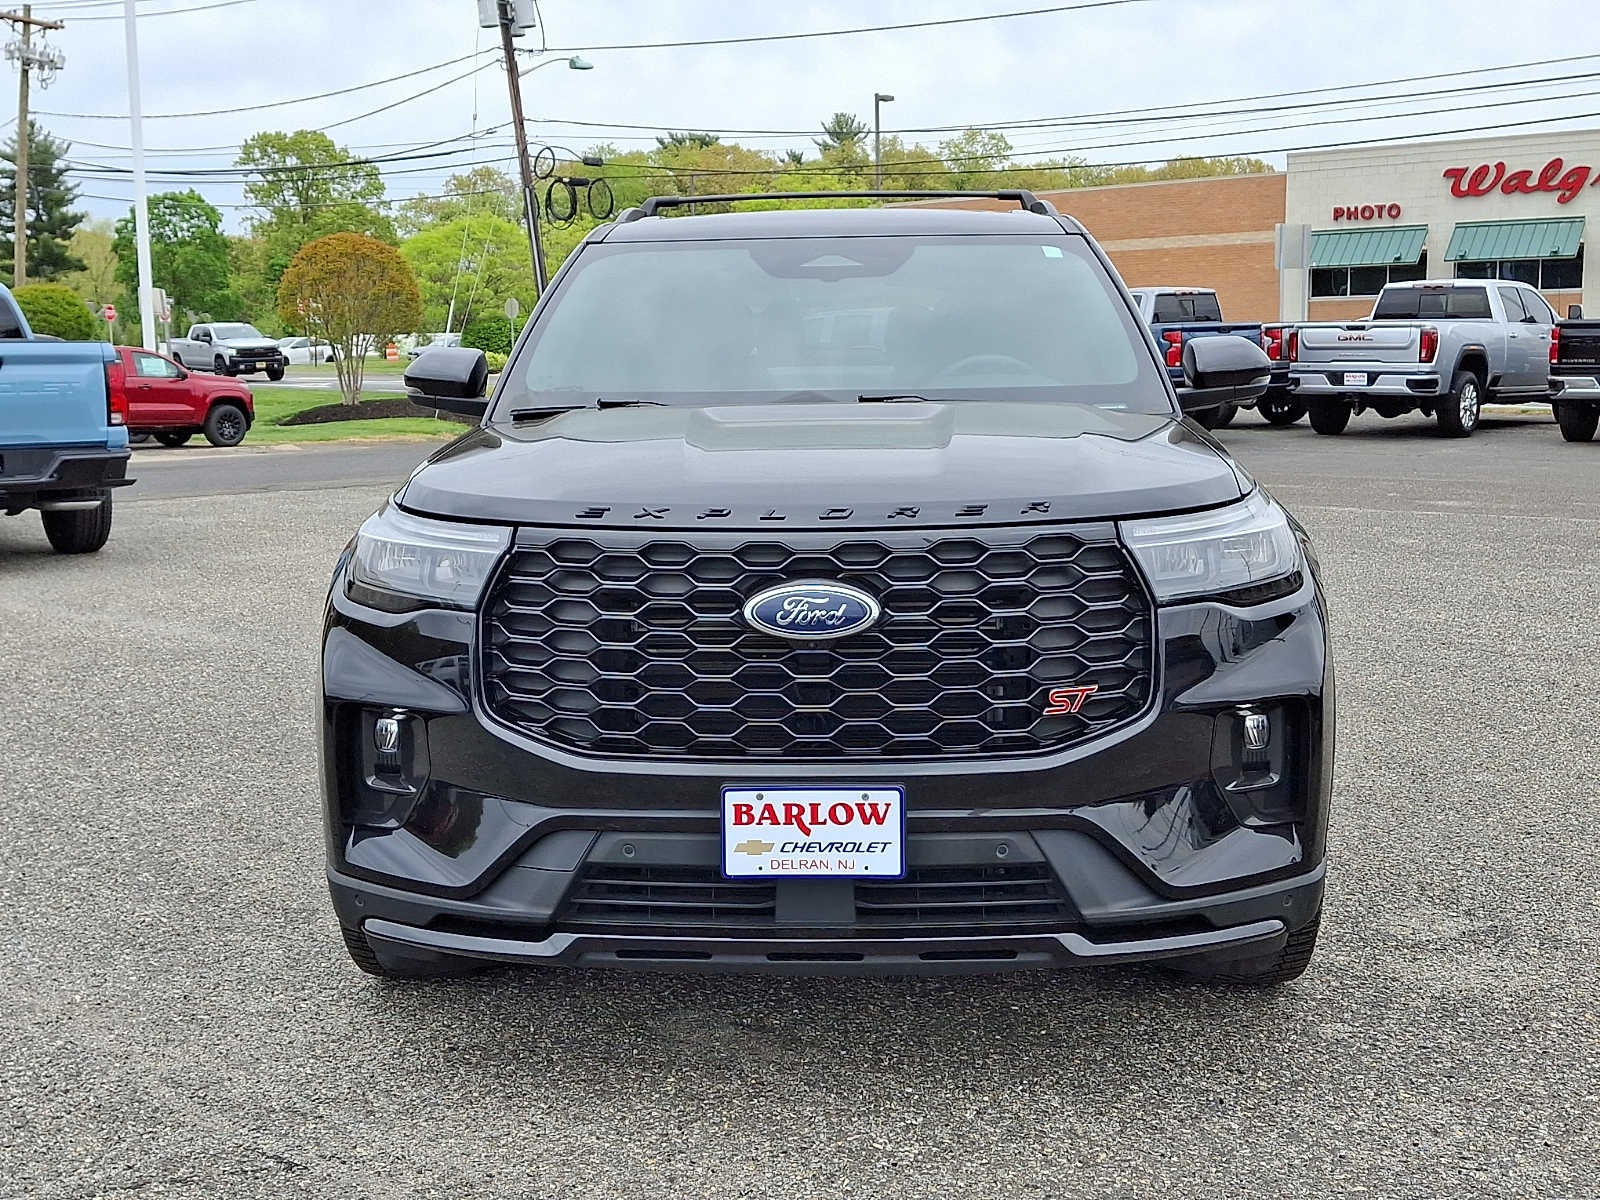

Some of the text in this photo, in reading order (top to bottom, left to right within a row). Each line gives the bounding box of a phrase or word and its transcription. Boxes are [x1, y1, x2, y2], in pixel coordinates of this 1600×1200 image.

[1443, 157, 1600, 204] Walg
[1333, 203, 1401, 221] PHOTO
[1337, 333, 1374, 342] GMC
[575, 501, 1051, 521] EXPLORER
[776, 596, 848, 626] Ford
[1043, 684, 1098, 715] ST
[732, 802, 892, 837] BARLOW
[780, 841, 892, 853] CHEVROLET
[770, 859, 855, 871] DELRAN, NJ
